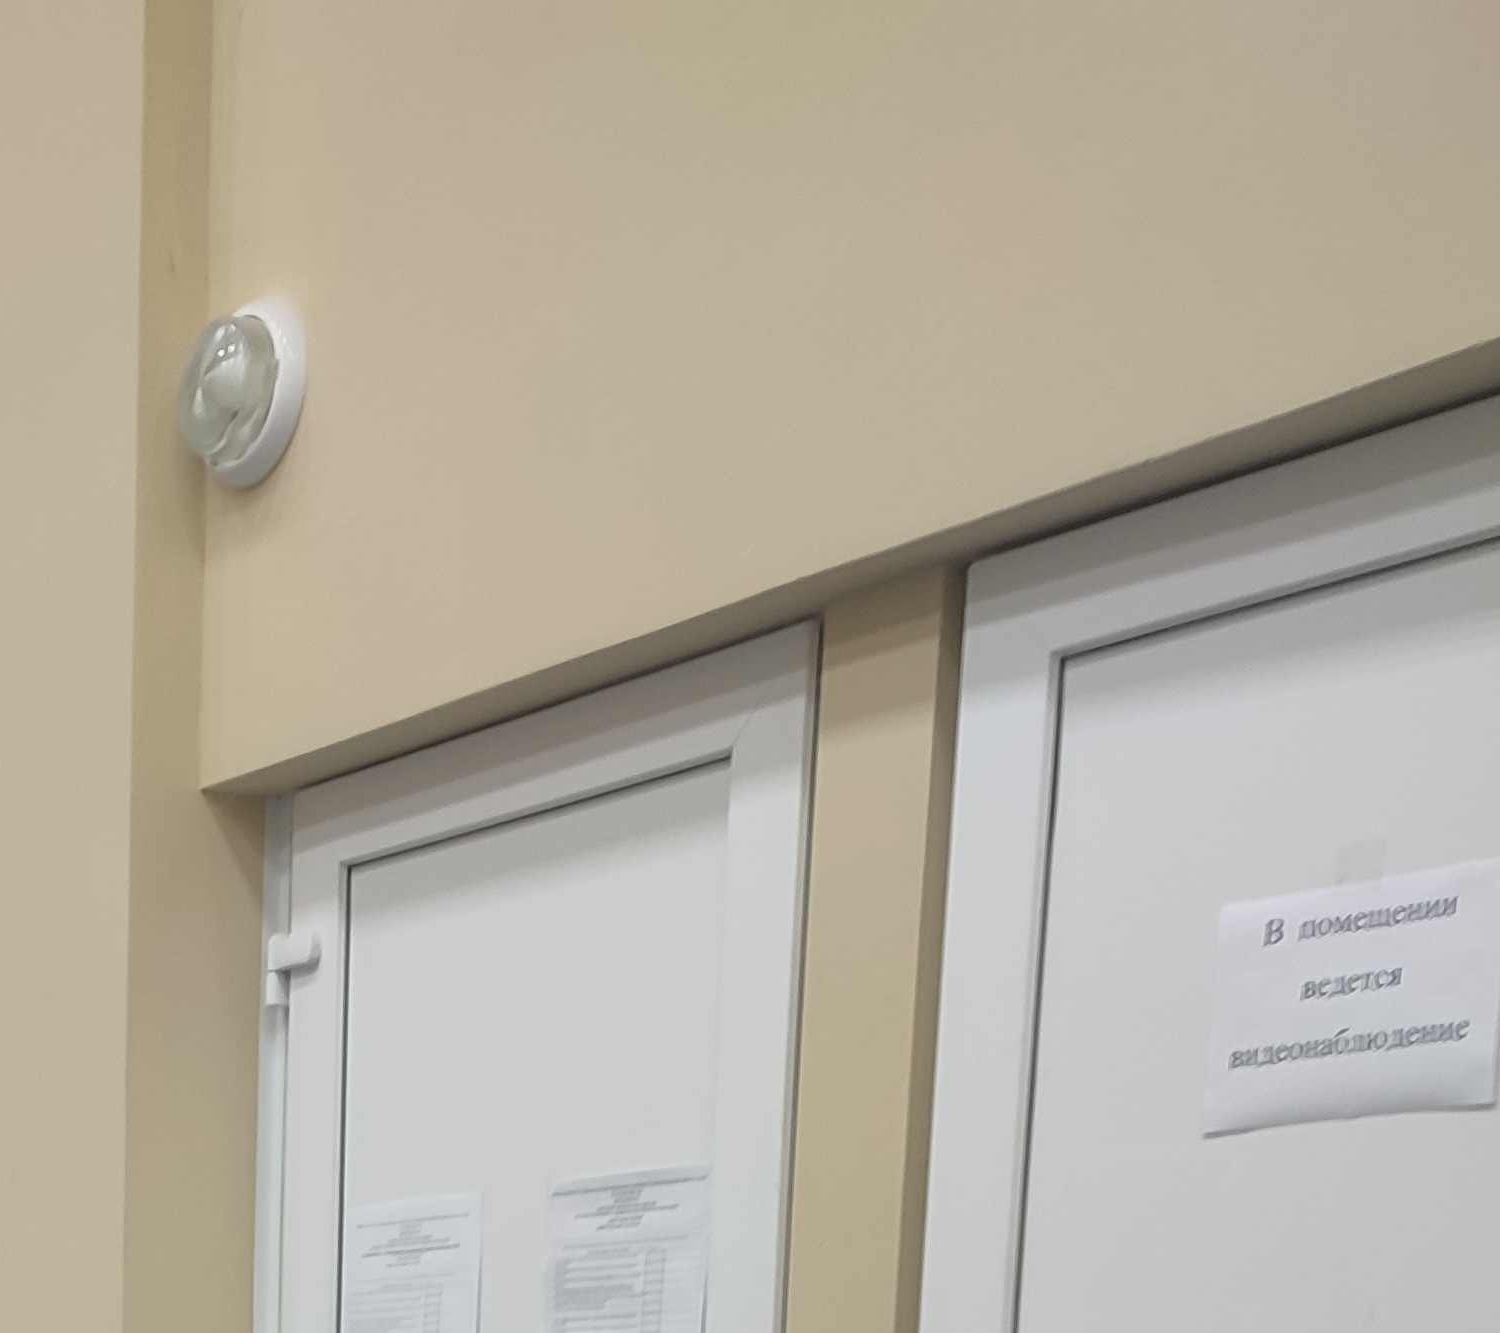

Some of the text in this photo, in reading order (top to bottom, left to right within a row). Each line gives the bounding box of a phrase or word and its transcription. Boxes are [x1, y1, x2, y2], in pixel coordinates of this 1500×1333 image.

[1262, 895, 1459, 947] В помещении
[1299, 966, 1404, 1001] ведется
[1227, 1019, 1471, 1071] видеонаблюдение
